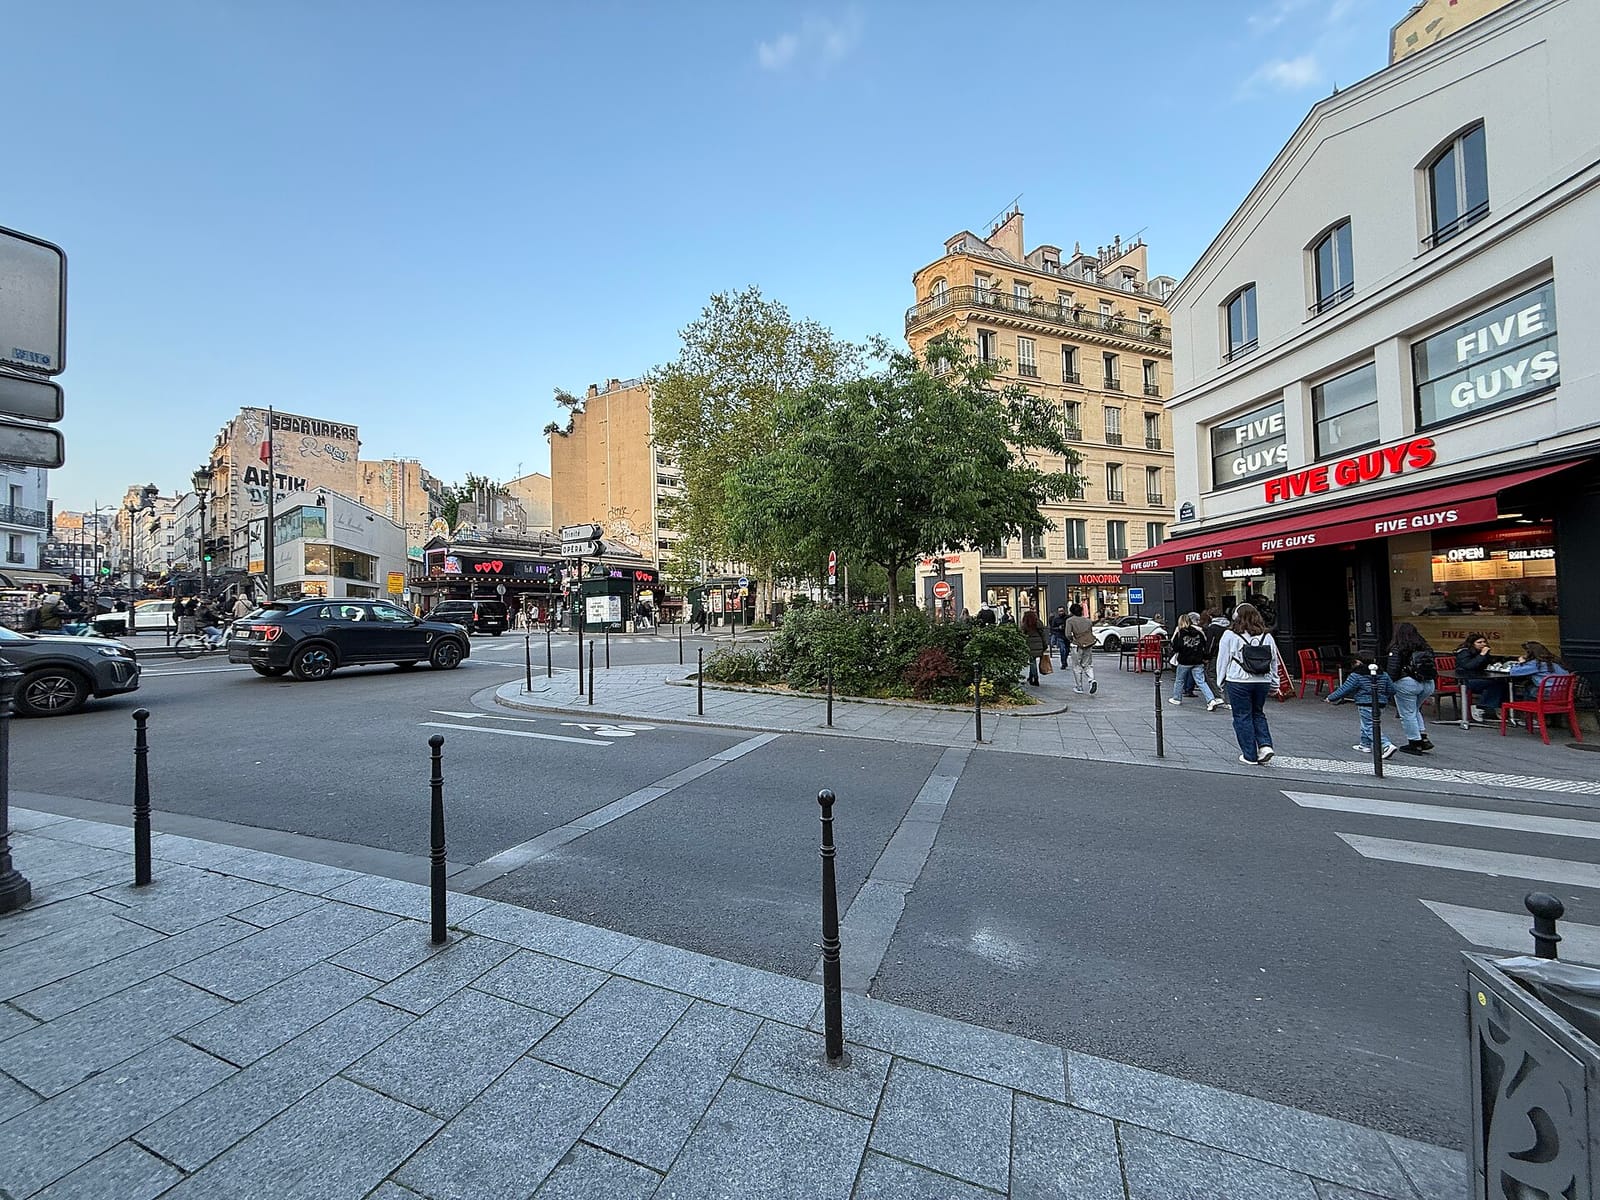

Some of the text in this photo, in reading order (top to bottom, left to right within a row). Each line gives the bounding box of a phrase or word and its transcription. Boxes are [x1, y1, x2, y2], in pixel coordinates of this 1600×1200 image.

[1457, 302, 1543, 362] FIVE
[1450, 351, 1558, 408] GUYS
[1235, 412, 1283, 445] FIVE
[1232, 444, 1287, 476] GUYS
[1264, 438, 1436, 503] FIVE GUYS
[1375, 510, 1458, 534] FIVE GUYS
[1261, 534, 1316, 551] FIVE GUYS
[1185, 549, 1223, 563] FIVE GUYS
[1448, 547, 1485, 560] OPEN
[1130, 559, 1158, 571] FIVE GUYS
[1222, 567, 1263, 579] MILKSHAKES
[1079, 574, 1120, 584] MONOPRIX
[1441, 630, 1465, 639] FIVE
